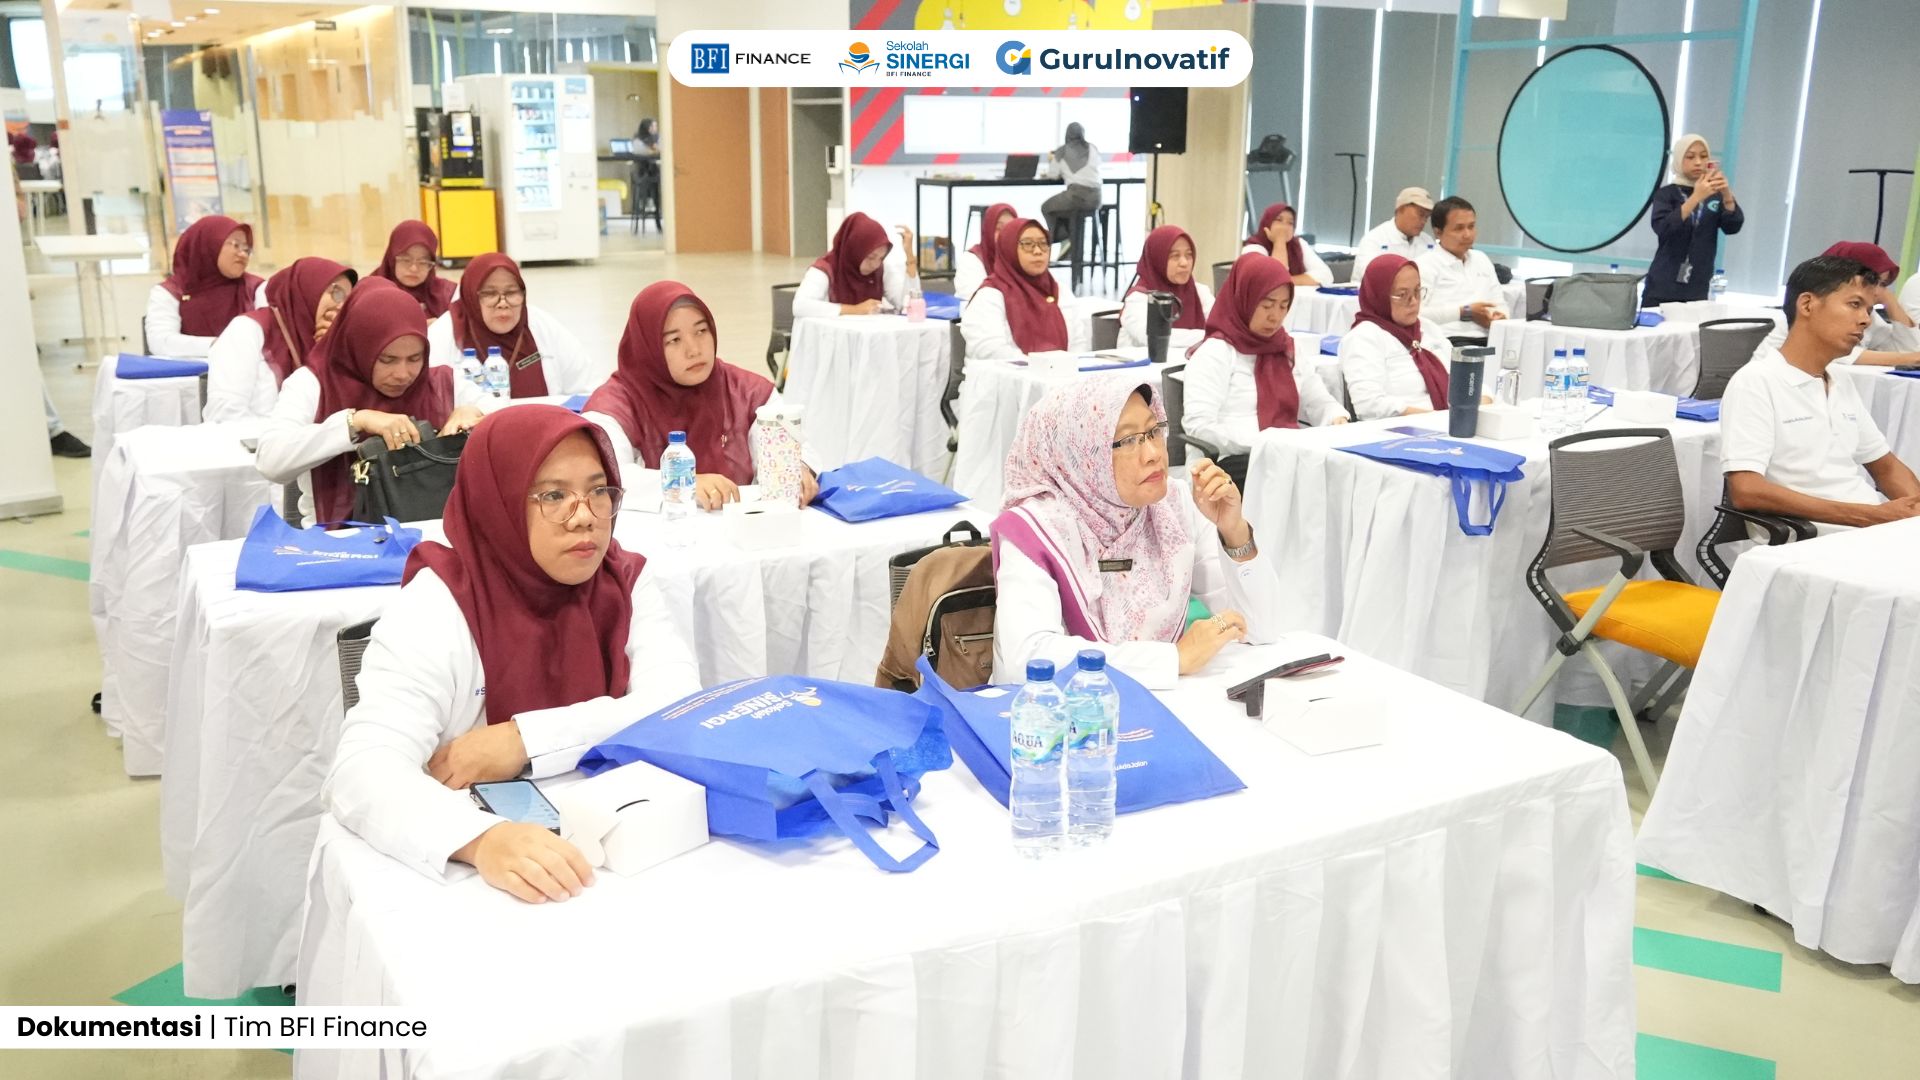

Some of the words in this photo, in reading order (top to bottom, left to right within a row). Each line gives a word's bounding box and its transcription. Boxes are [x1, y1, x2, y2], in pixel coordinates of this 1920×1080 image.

[699, 692, 783, 730] SINERGI
[750, 700, 793, 719] Sekolah
[1013, 730, 1044, 749] AQUA
